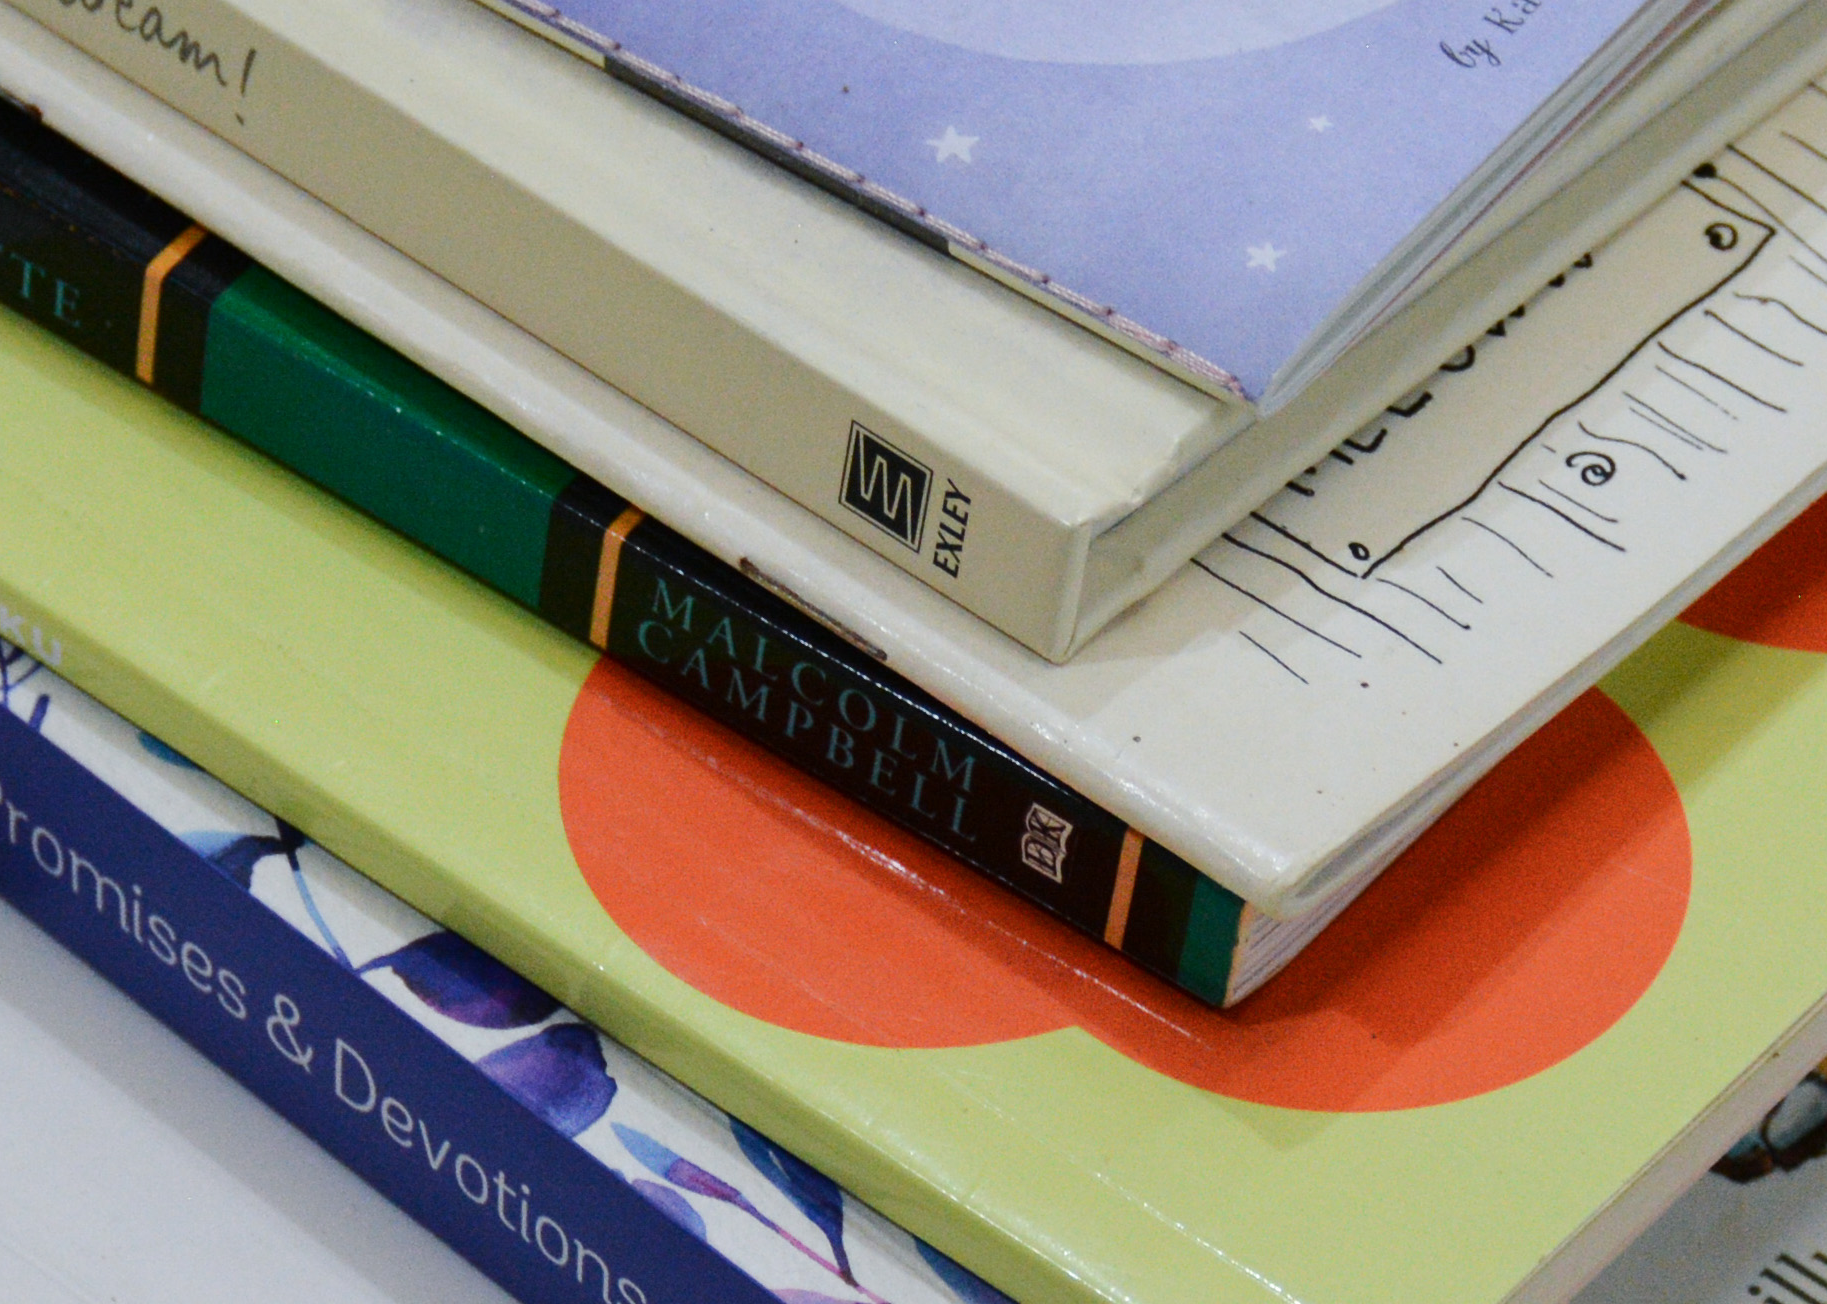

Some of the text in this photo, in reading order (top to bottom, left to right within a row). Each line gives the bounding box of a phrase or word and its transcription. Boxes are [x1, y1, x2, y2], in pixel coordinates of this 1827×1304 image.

[1439, 40, 1502, 70] by
[932, 477, 972, 579] EXLEY
[650, 576, 976, 793] MALCOLM
[636, 618, 976, 842] CAMPBELL
[1023, 804, 1070, 880] DK
[266, 994, 313, 1073] &
